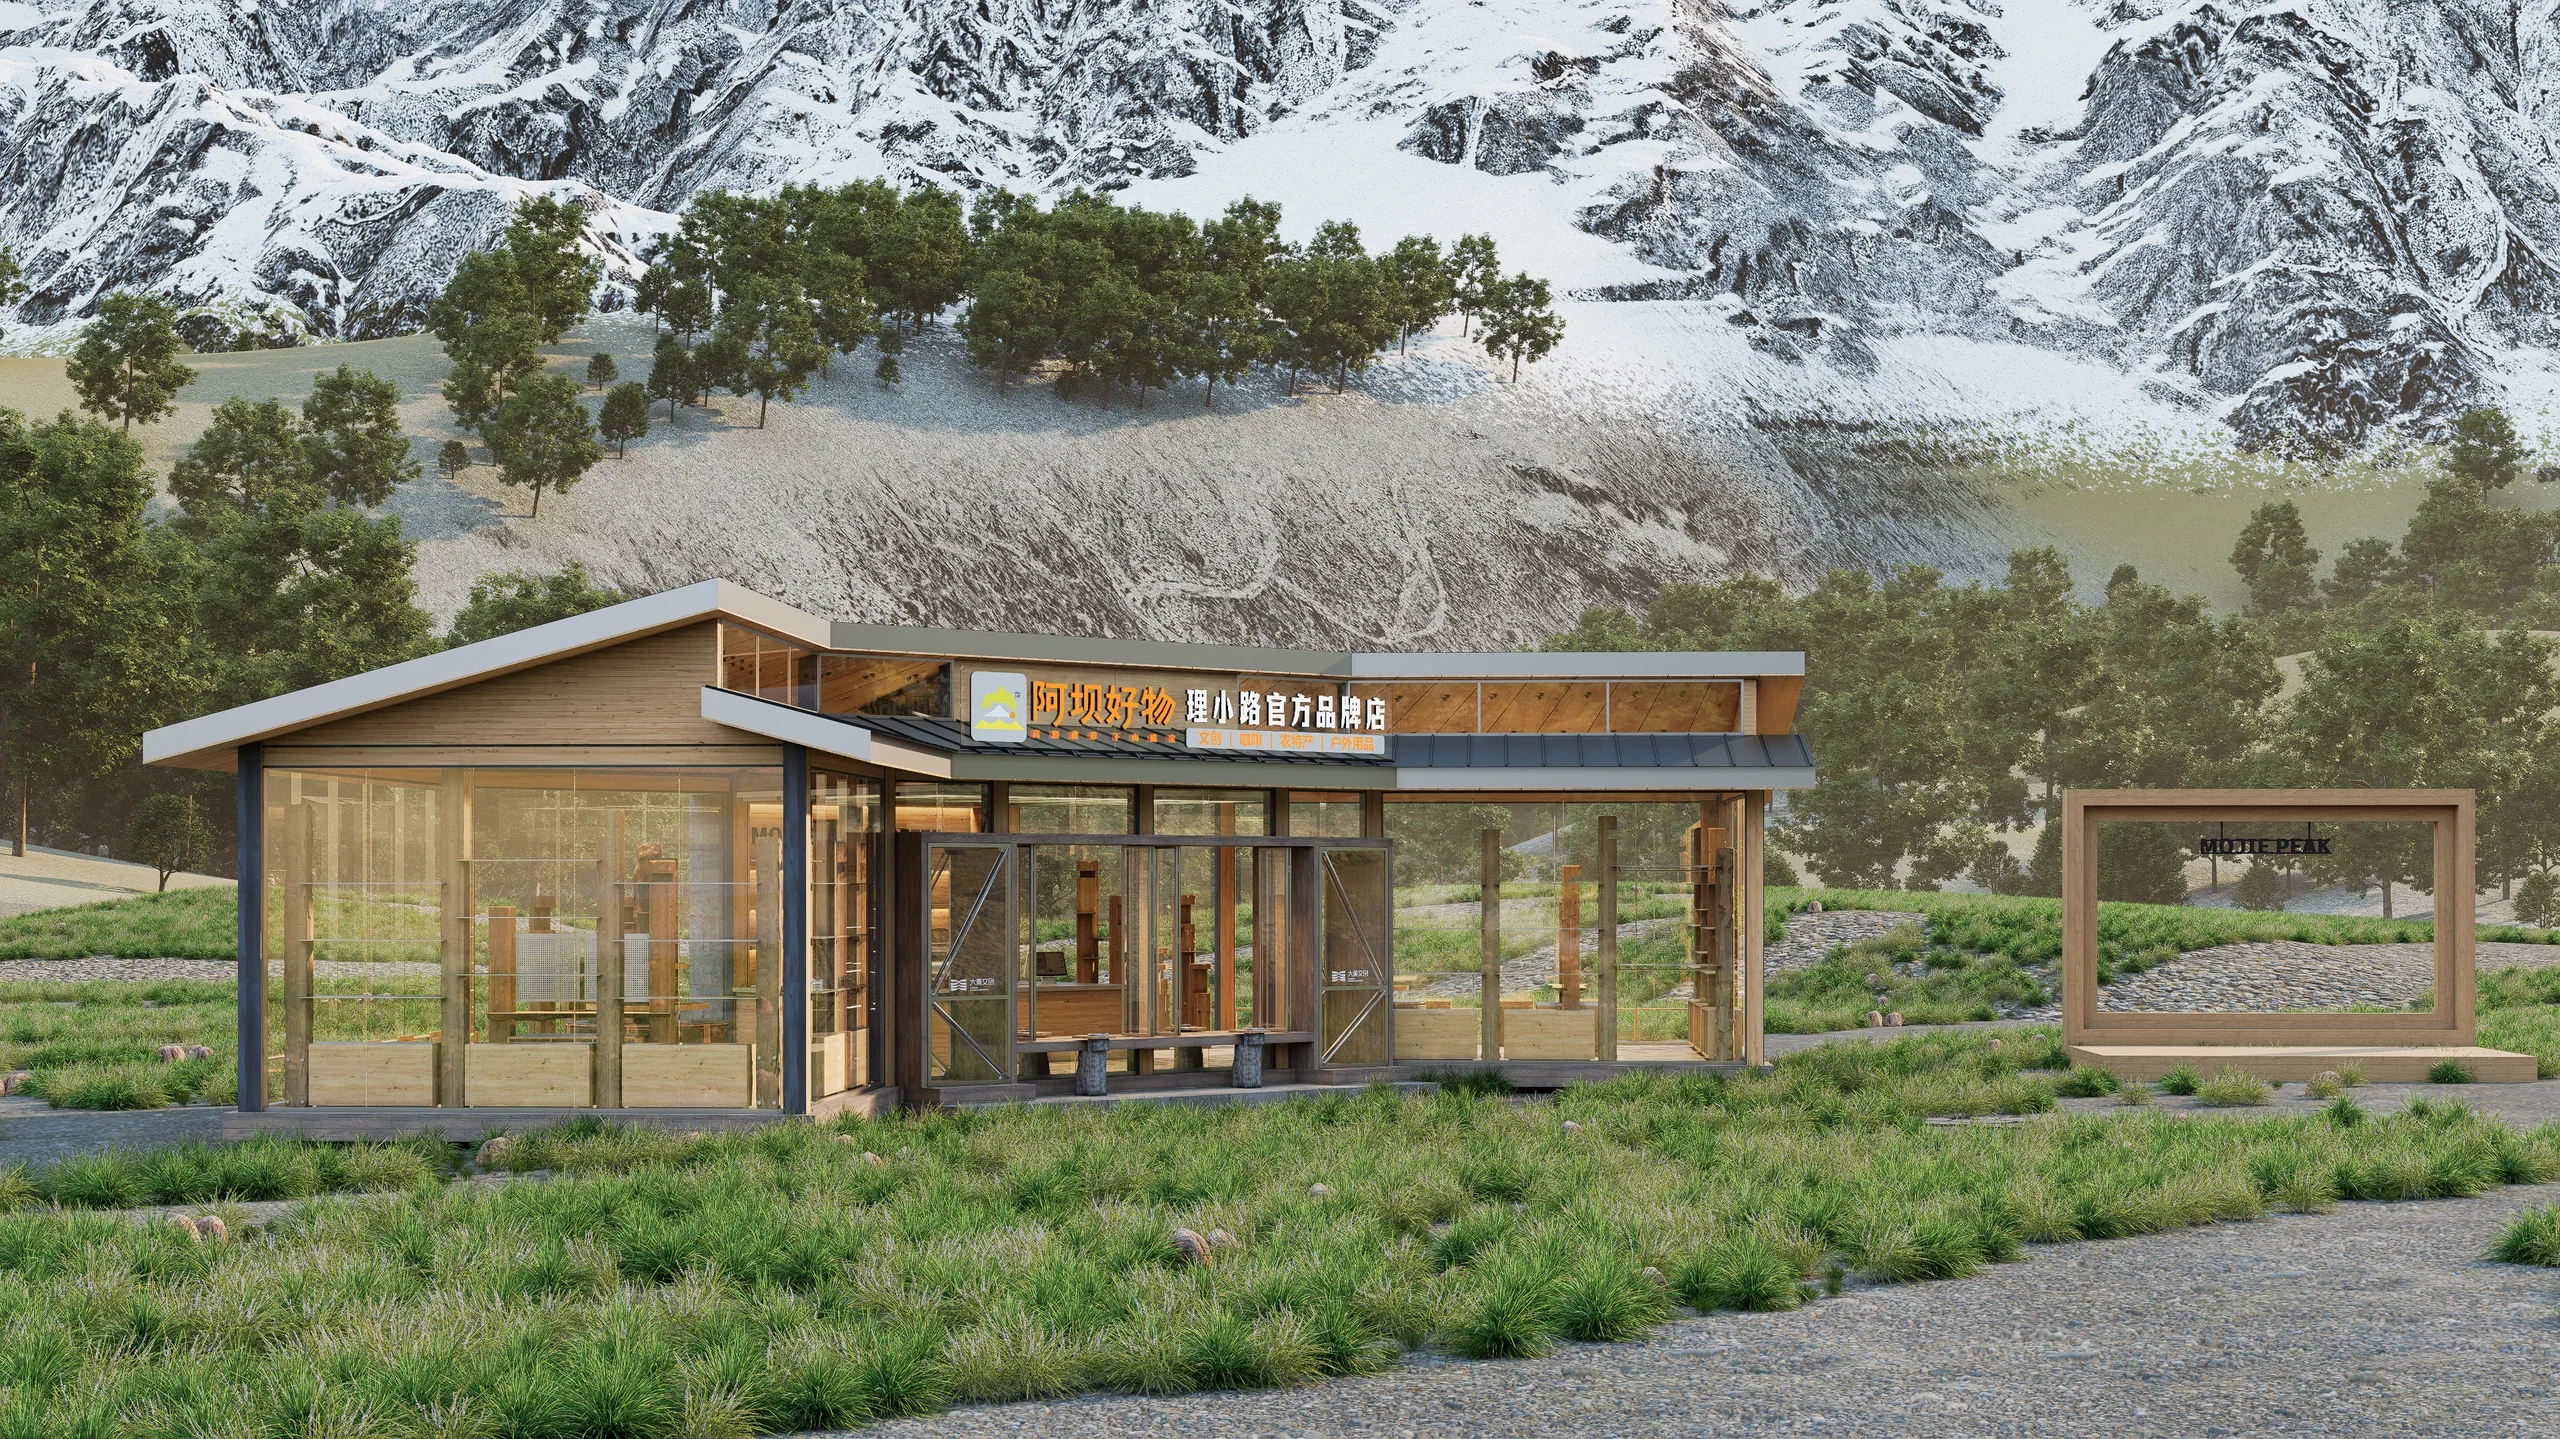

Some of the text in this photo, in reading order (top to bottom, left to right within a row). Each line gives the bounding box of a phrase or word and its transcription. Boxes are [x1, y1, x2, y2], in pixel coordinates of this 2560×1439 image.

[1031, 680, 1176, 730] 阿坝好物
[1186, 689, 1386, 731] 理小路官方品牌店
[1198, 731, 1375, 751] 文创 咖啡 农特产 户外用品
[2201, 838, 2332, 854] MOJIE PEAK
